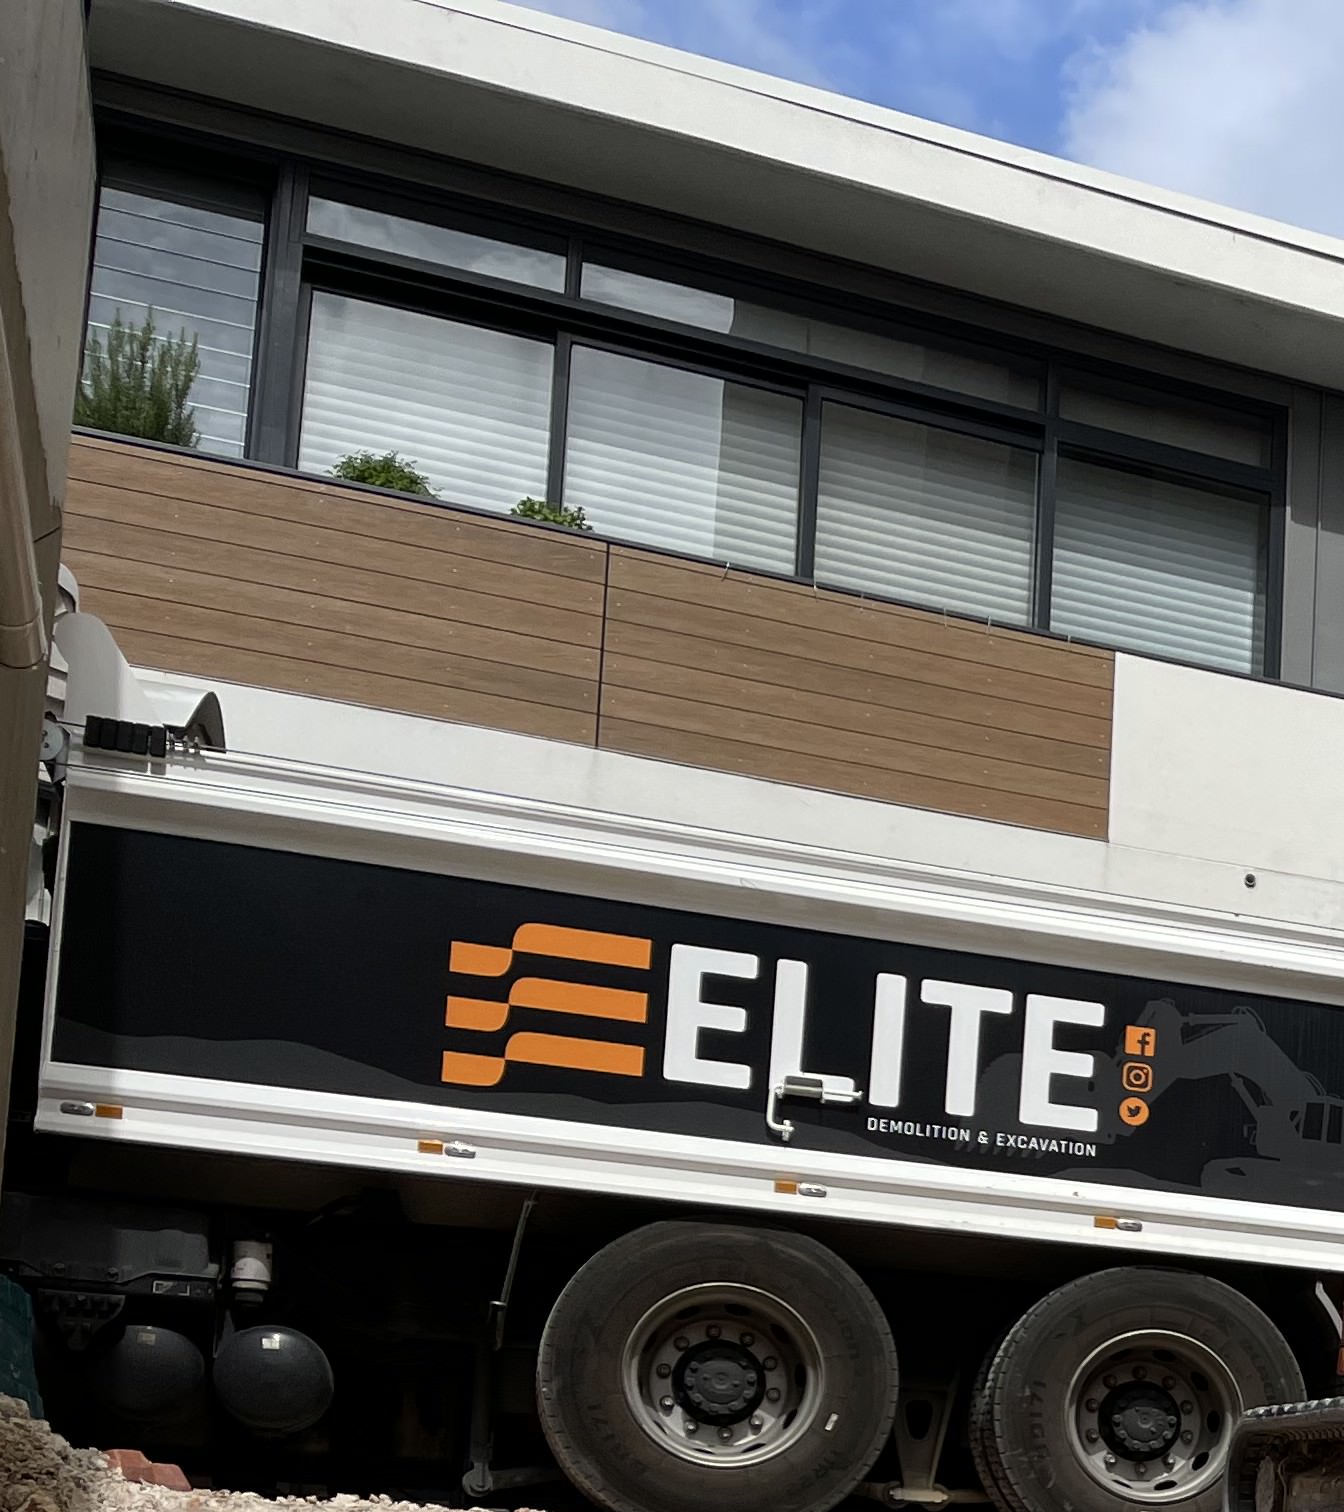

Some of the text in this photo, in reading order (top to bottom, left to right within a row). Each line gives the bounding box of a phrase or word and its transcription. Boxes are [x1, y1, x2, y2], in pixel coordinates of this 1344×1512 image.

[662, 943, 1106, 1132] ELITE
[866, 1116, 1097, 1158] DEMOLITION & EXCAVATION
